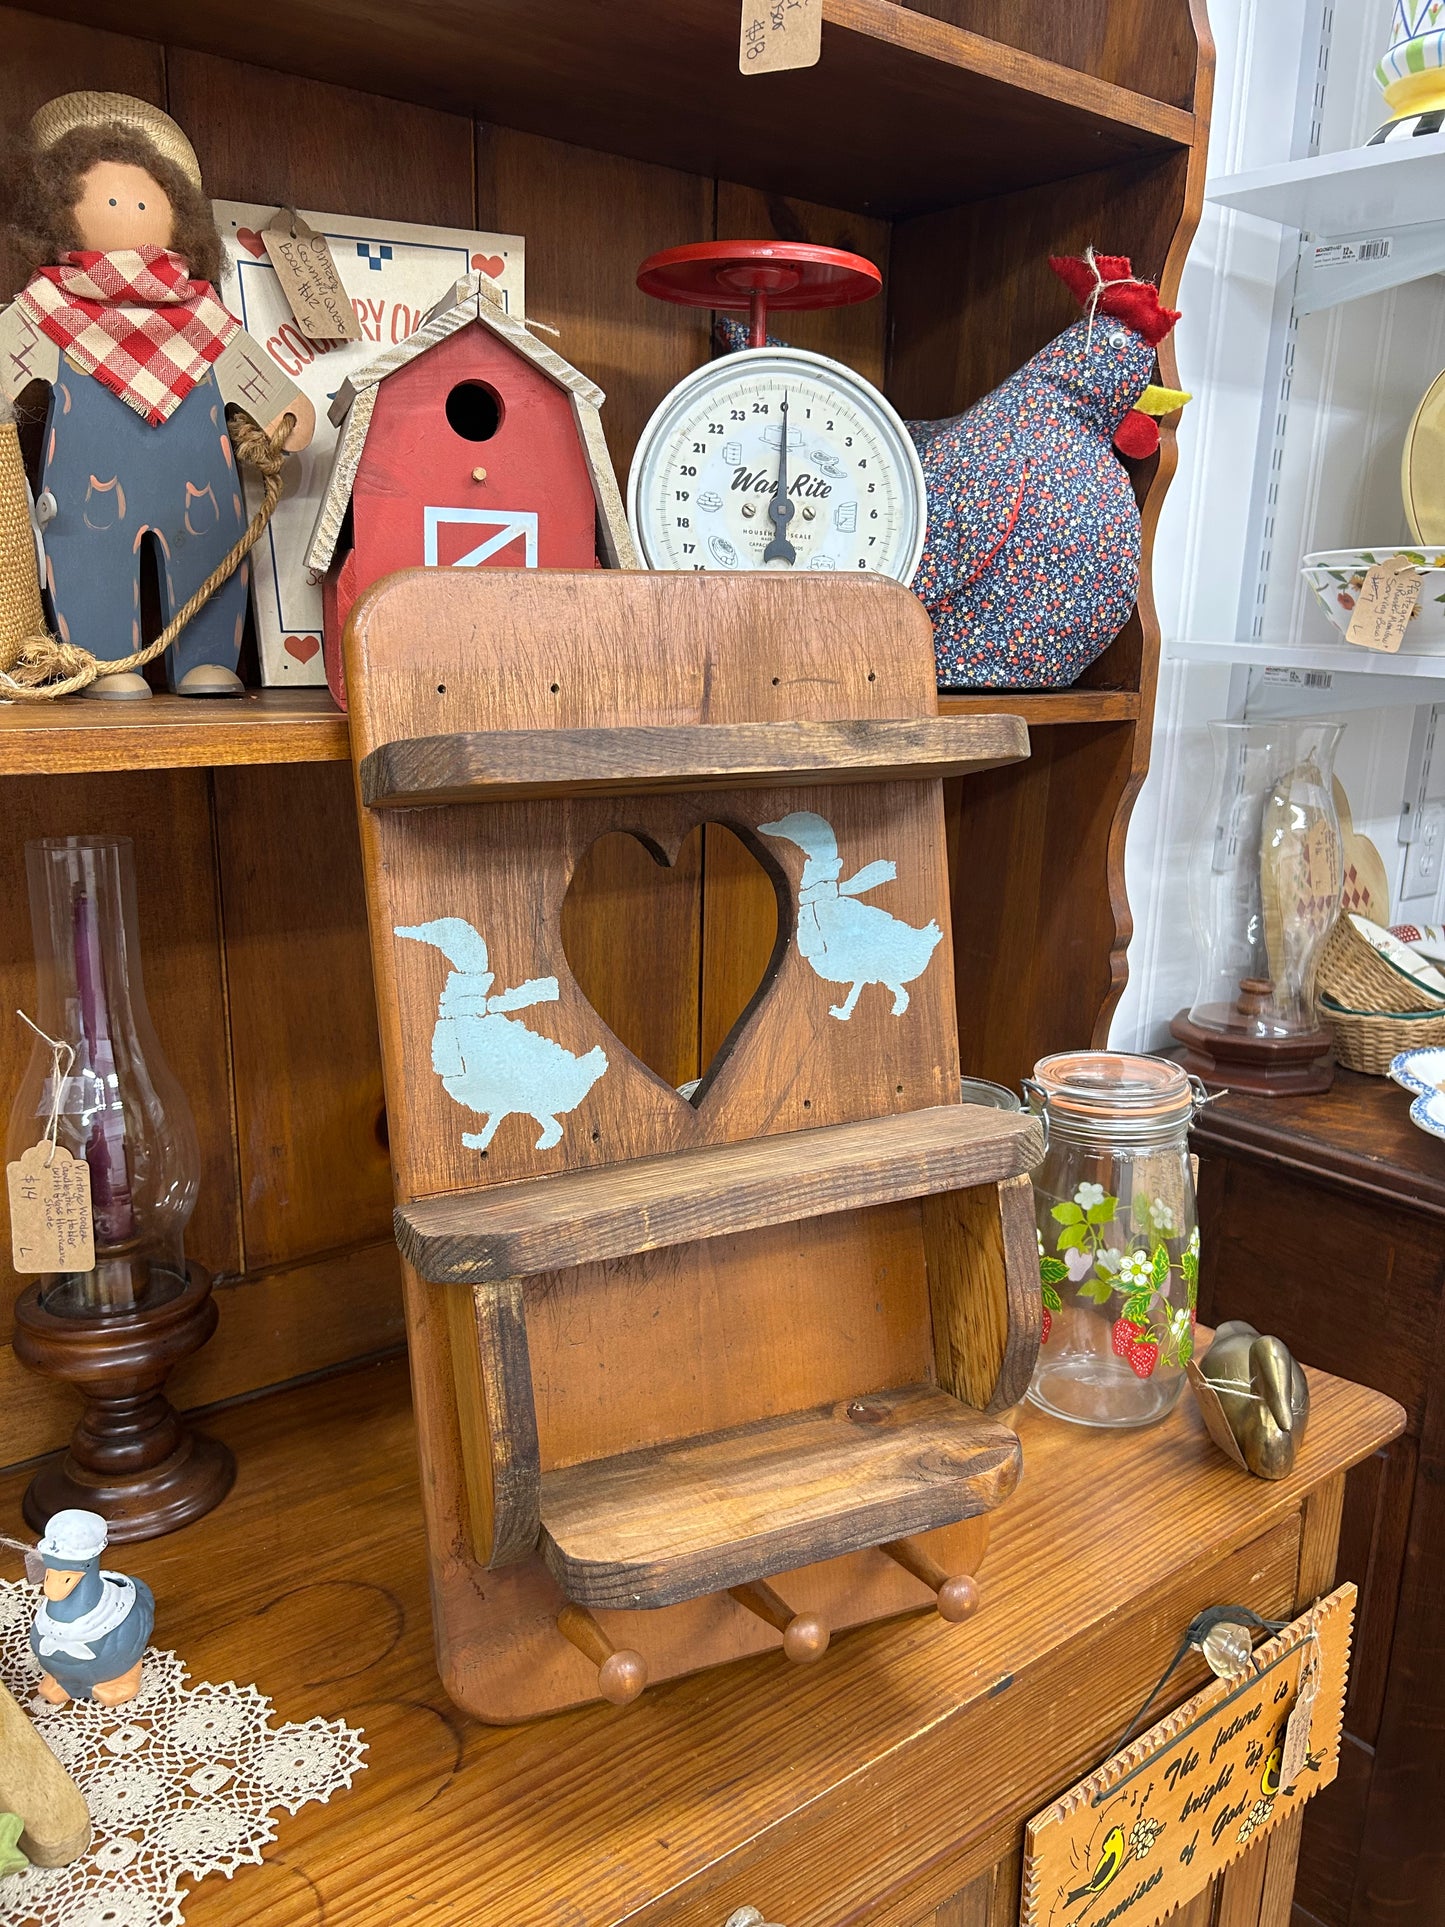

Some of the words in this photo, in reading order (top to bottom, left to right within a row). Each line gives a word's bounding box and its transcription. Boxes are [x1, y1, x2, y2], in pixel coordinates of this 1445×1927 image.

[745, 19, 766, 60] $18
[266, 299, 385, 376] CORY
[751, 403, 769, 414] 24
[806, 409, 811, 419] 1
[730, 410, 746, 421] 23
[708, 423, 724, 435] 22
[826, 421, 834, 431] 2
[845, 437, 853, 447] 3
[693, 443, 706, 454] 21
[858, 459, 867, 469] 4
[680, 465, 697, 477] 20
[867, 483, 875, 493] 5
[676, 491, 690, 502] 19
[870, 509, 878, 519] 6
[677, 517, 690, 528] 18
[868, 536, 876, 546] 7
[683, 543, 696, 554] 17
[858, 559, 866, 568] 8
[20, 1175, 40, 1200] $14
[1164, 1747, 1200, 1791] The
[1209, 1703, 1263, 1764] future
[1273, 1680, 1289, 1704] is
[1179, 1763, 1235, 1823] bright
[1245, 1744, 1264, 1769] as
[1179, 1829, 1200, 1866] of
[1211, 1789, 1252, 1847] God.
